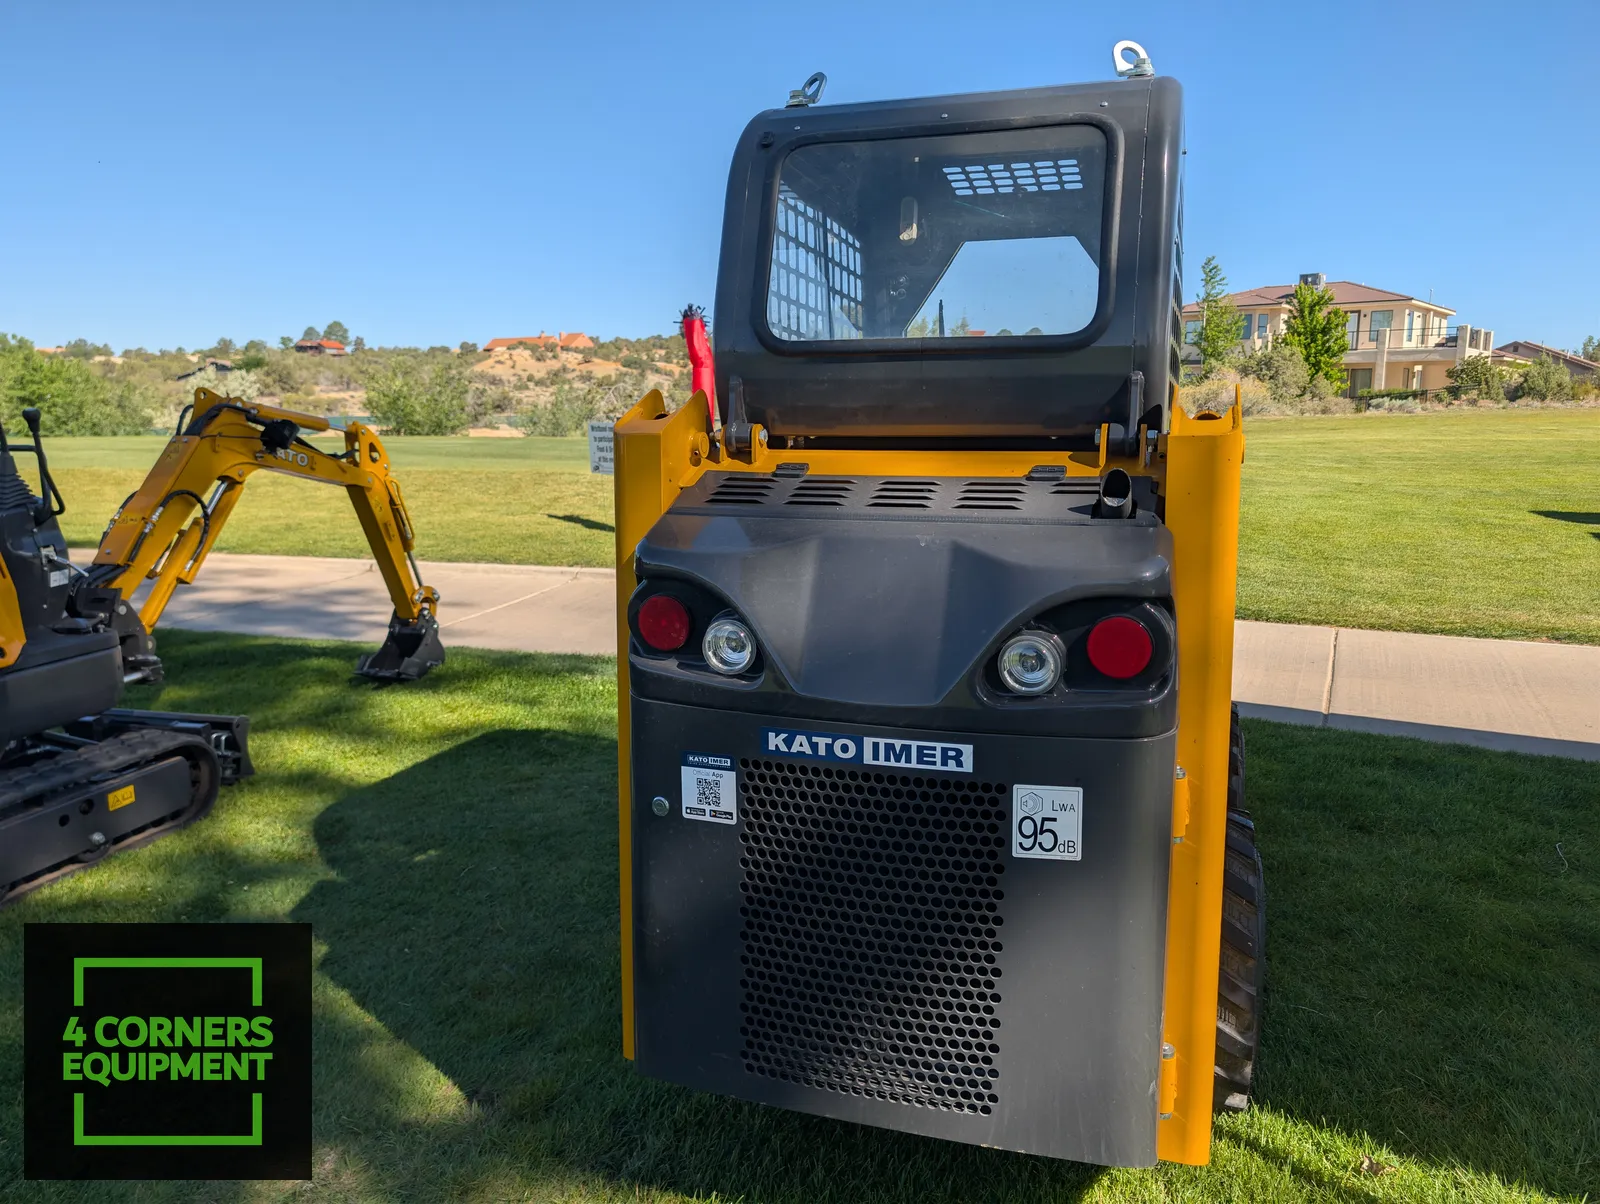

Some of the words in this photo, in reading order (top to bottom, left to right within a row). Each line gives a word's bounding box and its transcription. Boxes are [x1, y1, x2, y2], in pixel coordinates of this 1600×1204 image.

[276, 446, 309, 467] ATO
[768, 731, 857, 759] KATO
[871, 740, 965, 769] IMER
[688, 755, 708, 763] KATO
[709, 758, 730, 766] IMER
[711, 771, 724, 779] App
